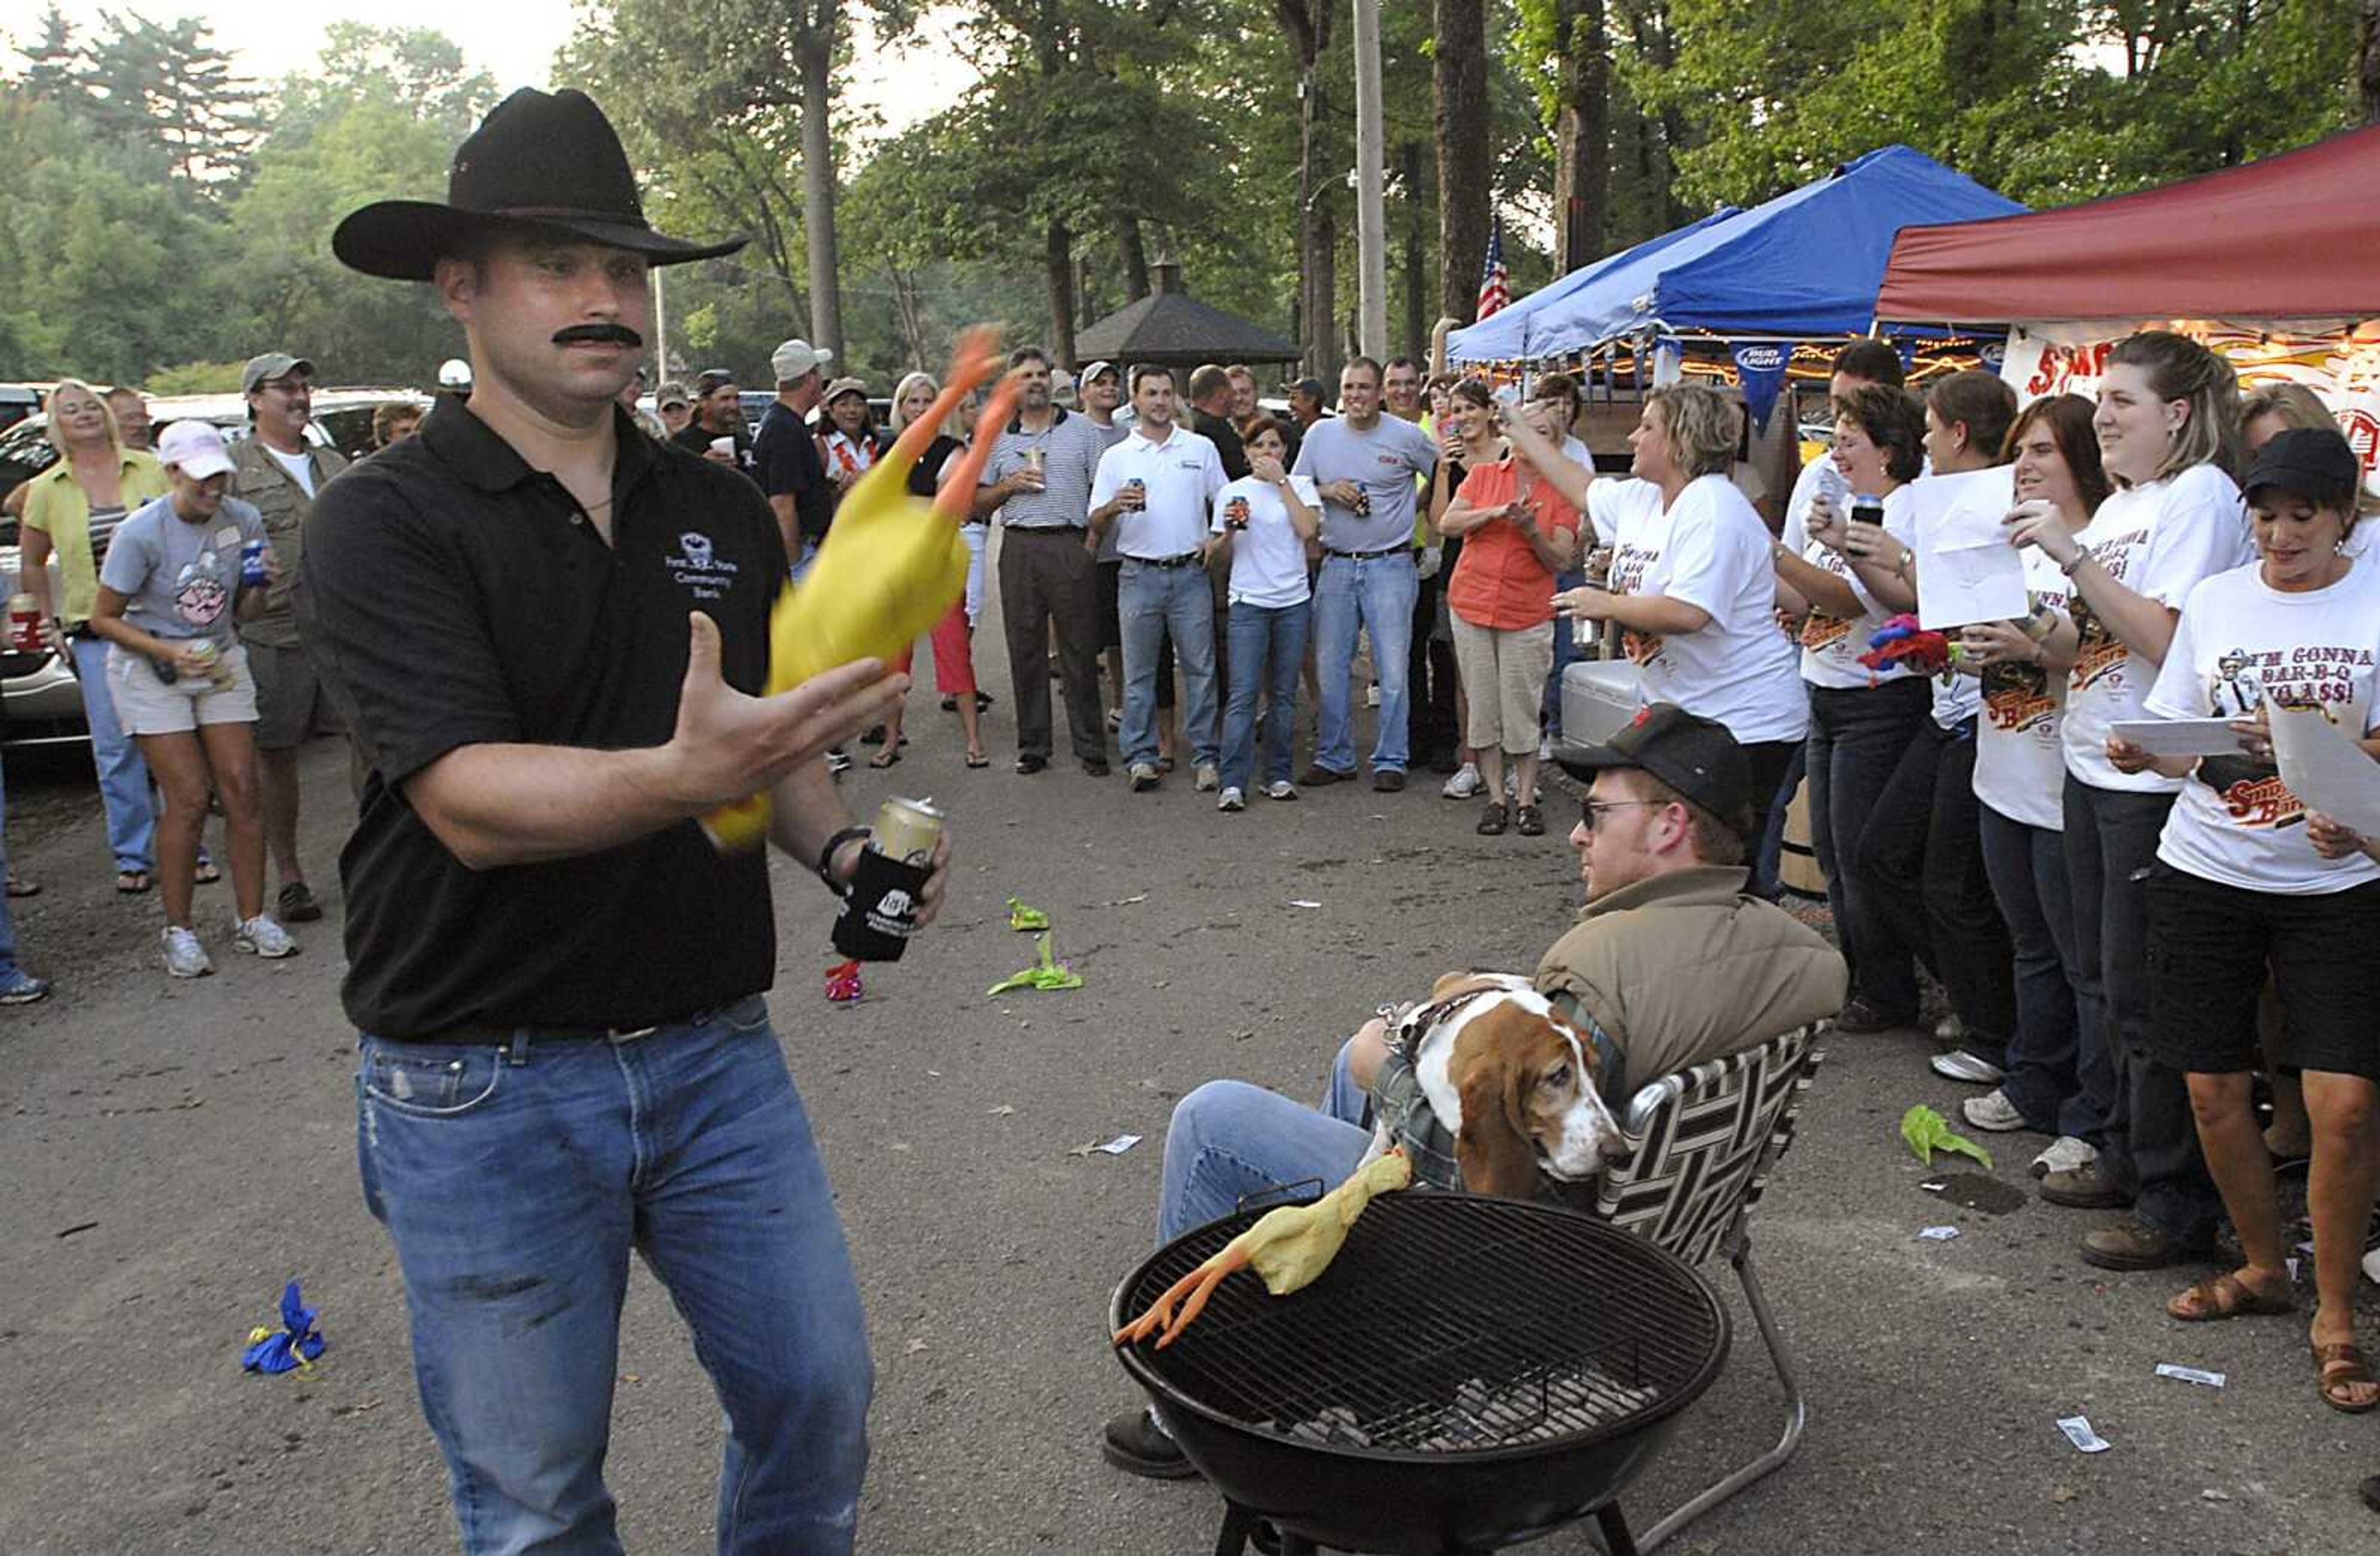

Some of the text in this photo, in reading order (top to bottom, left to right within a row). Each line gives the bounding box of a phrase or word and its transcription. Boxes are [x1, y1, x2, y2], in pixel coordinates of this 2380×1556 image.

[1742, 356, 1784, 366] LIGHT
[2292, 647, 2375, 666] GONNA
[2261, 663, 2351, 683] BAR-B-Q
[2301, 683, 2353, 704] ASS!
